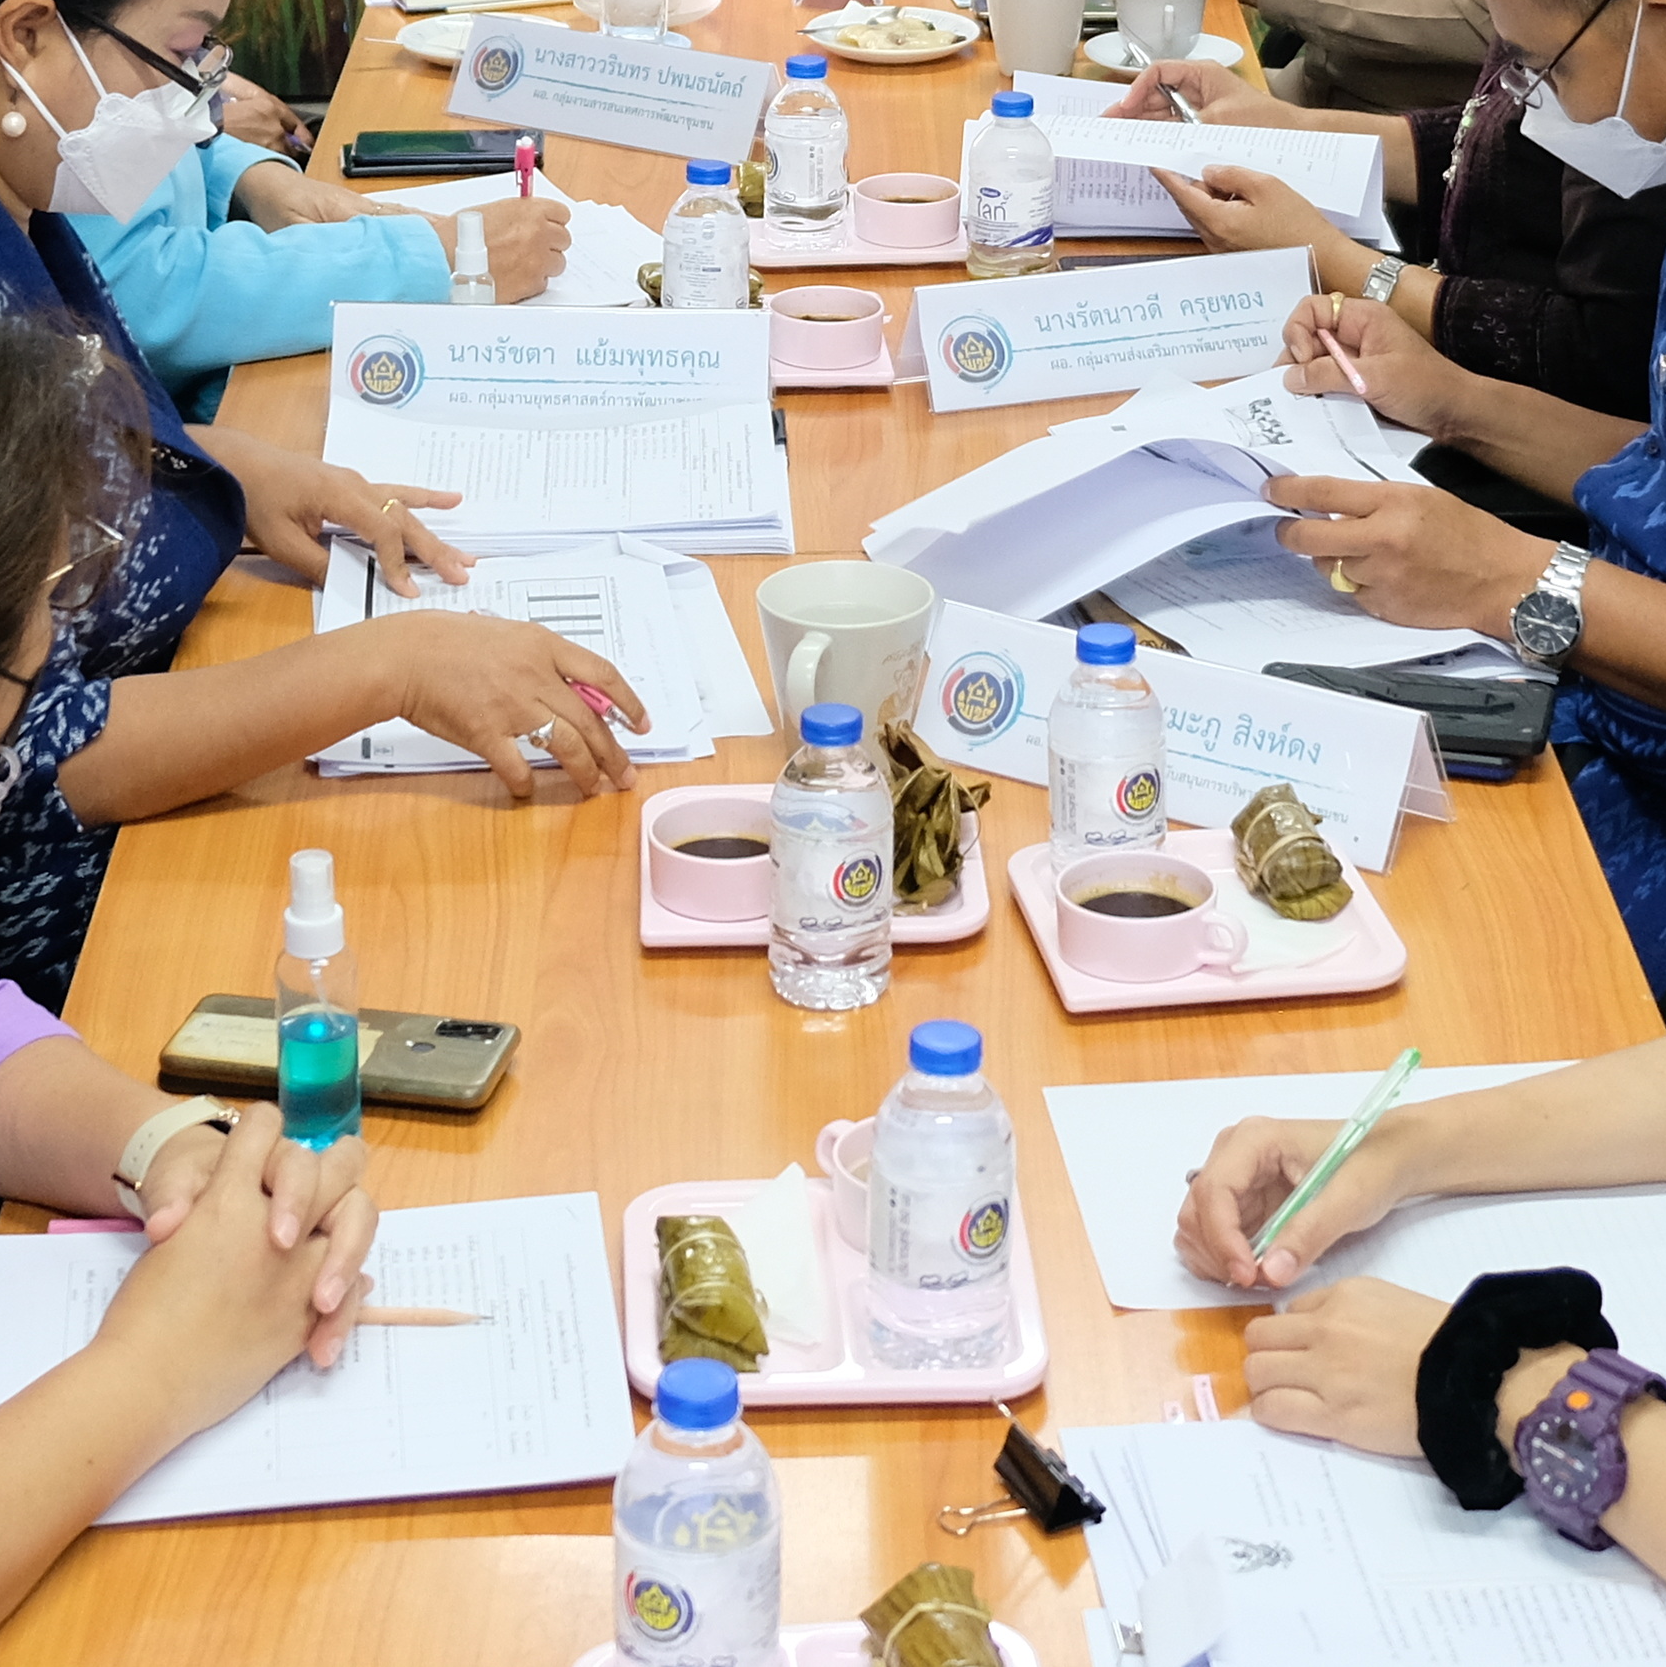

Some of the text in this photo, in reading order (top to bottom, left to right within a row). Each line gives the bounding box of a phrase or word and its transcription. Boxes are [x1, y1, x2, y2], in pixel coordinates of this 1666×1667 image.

[535, 46, 651, 83] นางสาววรินทร
[1033, 288, 1264, 334] นางรัตนาวดี ครุยทอง
[448, 335, 721, 379] นางรัชตา แย้มพุทธคุณ
[1050, 333, 1268, 372] ผอ. กลุ่มงานส่งเสริมการพัฒนาชุมชน
[448, 390, 473, 404] ผอ.
[1163, 706, 1321, 765] มะภู สิงห์ดง
